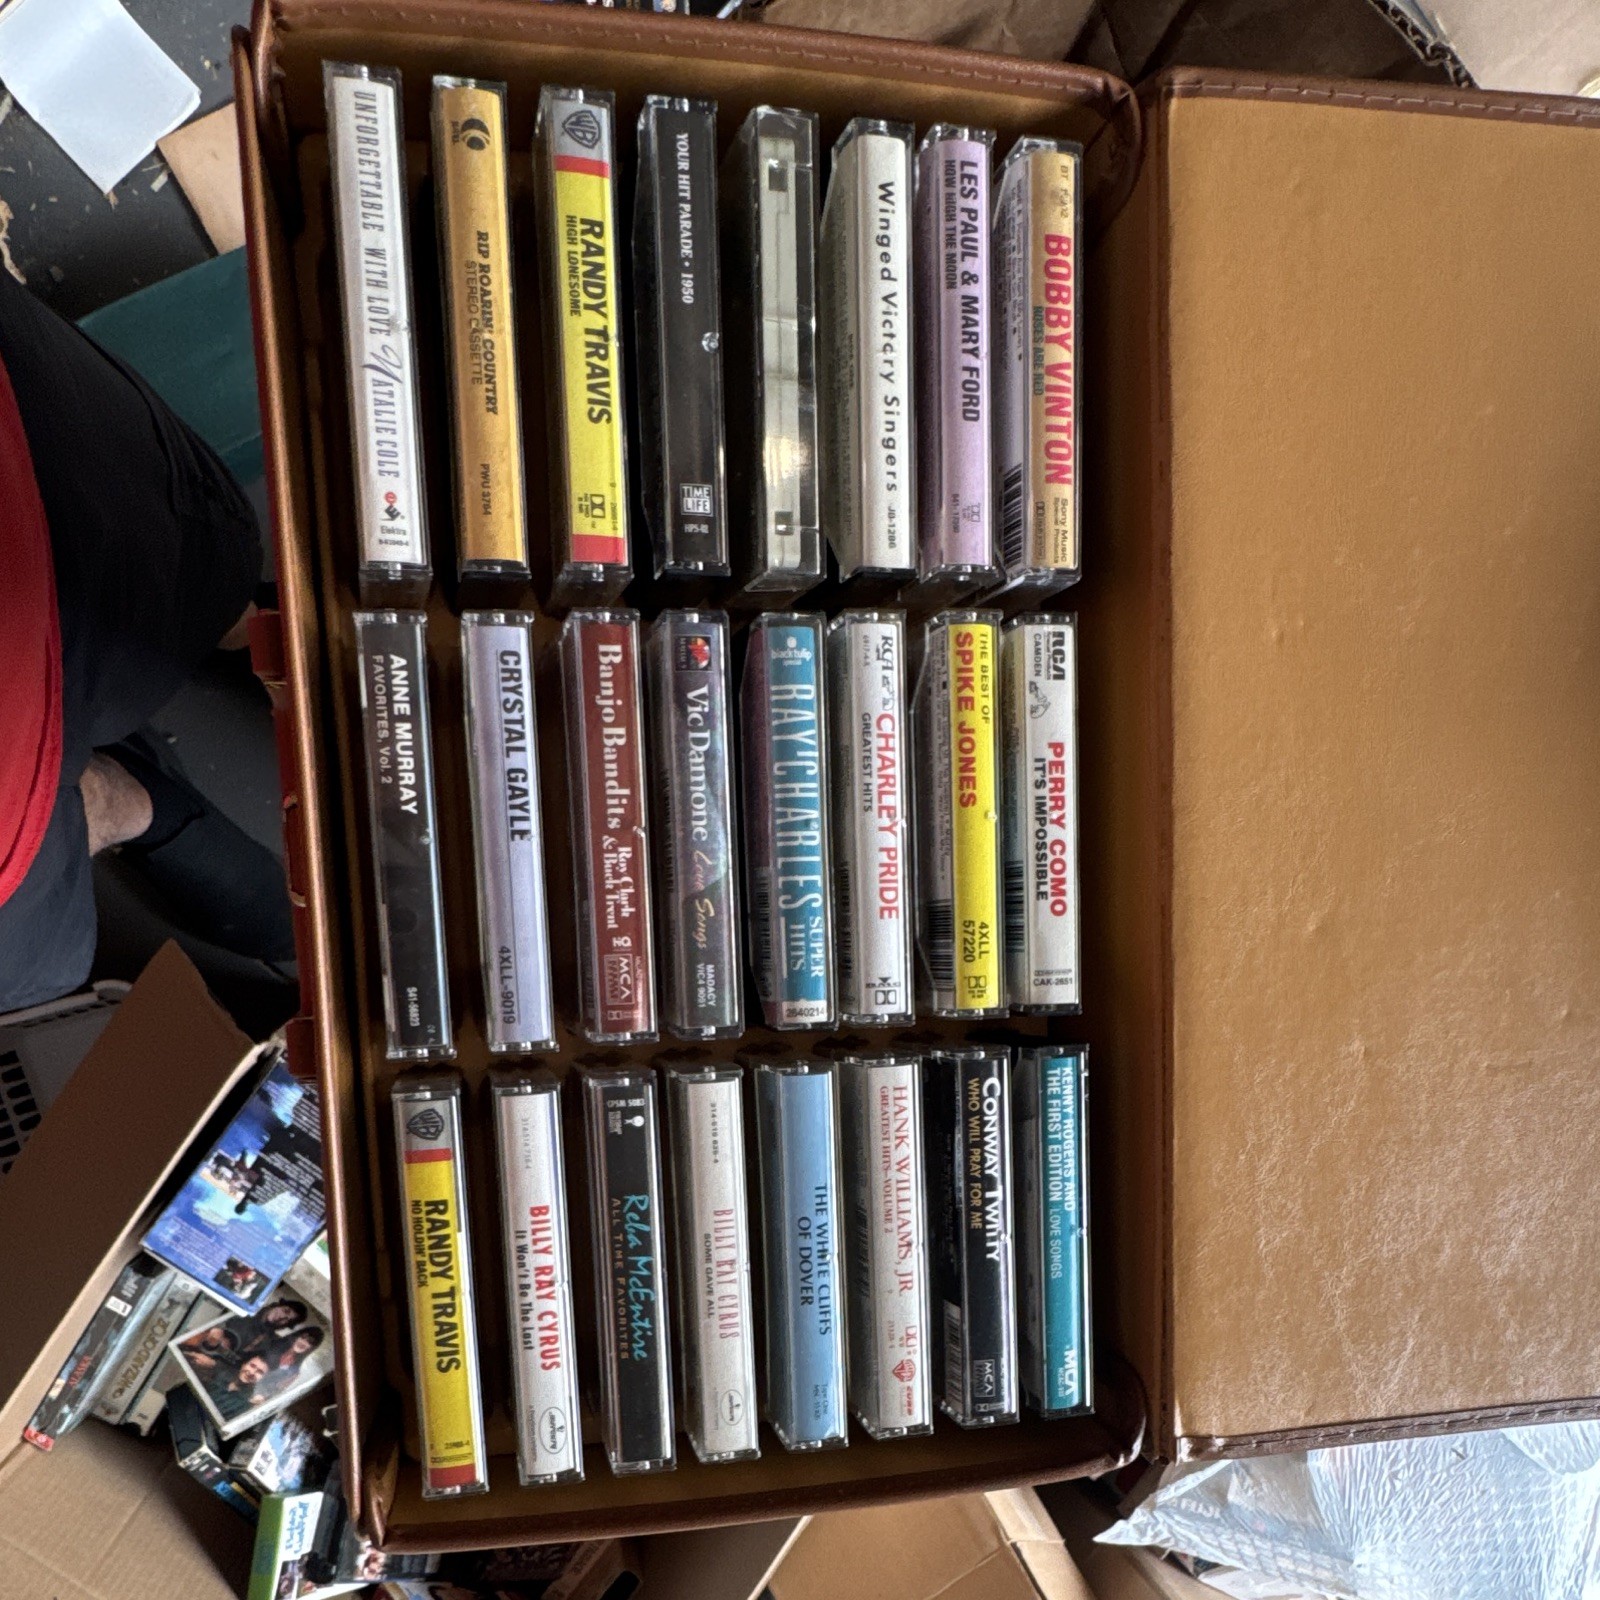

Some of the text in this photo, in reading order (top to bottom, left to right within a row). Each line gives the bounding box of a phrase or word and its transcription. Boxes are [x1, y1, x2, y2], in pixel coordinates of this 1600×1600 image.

[353, 91, 391, 335] UNFORGETTABLE WITH LOVE
[676, 132, 695, 303] YOUR HIT PARADE 1950
[944, 160, 958, 290] HOW HIGH THE MOON
[1060, 164, 1069, 180] BT
[565, 214, 582, 316] HIGH LONESOME
[580, 217, 612, 424] RANDY TRAVIS
[960, 160, 980, 422] LES PAUL & MARY FORD
[465, 260, 482, 385] STEREO CASSETTE
[476, 231, 499, 415] RIP ROARIN' COUNTRY
[876, 182, 901, 492] Winged Victory Singers
[1033, 305, 1045, 396] ROSES ARE RED
[1044, 233, 1073, 485] BOBBY VINTON
[361, 344, 404, 477] NATALIE COLE
[479, 463, 491, 488] PWU
[681, 485, 711, 499] TIME
[683, 498, 710, 513] LIFE
[1058, 497, 1069, 562] Sony Music
[875, 634, 894, 671] RCA
[980, 631, 991, 724] THE BEST OF
[1033, 633, 1043, 677] CAMDEN
[1051, 631, 1065, 681] RCA
[372, 655, 392, 784] FAVORITES, Vol. 2
[389, 654, 418, 815] ANNE MURRAY
[499, 649, 532, 842] CRYSTAL GAYLE
[595, 644, 630, 829] Banjo Bandits
[685, 684, 712, 841] Vic Damone
[770, 684, 818, 748] RAY
[861, 712, 873, 812] GREATEST HITS
[955, 631, 978, 809] SPIKE JONES
[773, 761, 823, 910] CHARLES
[875, 713, 899, 920] CHARLEY PRIDE
[1033, 757, 1048, 901] IT'S IMPOSSIBLE
[1048, 741, 1067, 917] PERRY COMO
[602, 835, 619, 929] & Buck Trent
[616, 846, 636, 917] Roy Clark
[691, 849, 716, 949] Love Songs
[498, 945, 516, 1025] 4XLL-9019
[619, 957, 631, 999] MCA
[696, 963, 707, 985] VIC4
[706, 964, 717, 1006] MADACY
[789, 922, 806, 971] HITS
[809, 916, 825, 978] SUPER
[963, 920, 976, 964] 57220
[978, 921, 990, 960] 4XLL
[879, 1086, 892, 1143] GREATEST
[967, 1078, 983, 1230] WHO WILL PRAY FOR ME
[982, 1077, 1001, 1178] CONWAY
[1062, 1067, 1076, 1211] KENNY ROGERS AND
[892, 1085, 914, 1295] HANK WILLIAMS, JR
[1047, 1068, 1063, 1279] THE FIRST EDITION LOVE SONGS
[411, 1199, 428, 1288] NO HOLDIN' BACK
[425, 1199, 461, 1373] RANDY TRAVIS
[515, 1230, 534, 1351] It Won't Be The Last
[529, 1205, 561, 1371] BILLY RAY CYRUS
[611, 1198, 629, 1359] ALL TIME FAVORITES
[623, 1194, 654, 1361] Reba McEntire
[703, 1233, 715, 1319] SOME GAVE ALL
[712, 1209, 740, 1339] BILLY RAY CYRUS
[797, 1216, 814, 1306] OF DOVER
[814, 1184, 832, 1336] THE WHITE CLIFFS
[984, 1362, 994, 1393] MCA
[1064, 1348, 1078, 1395] MCA
